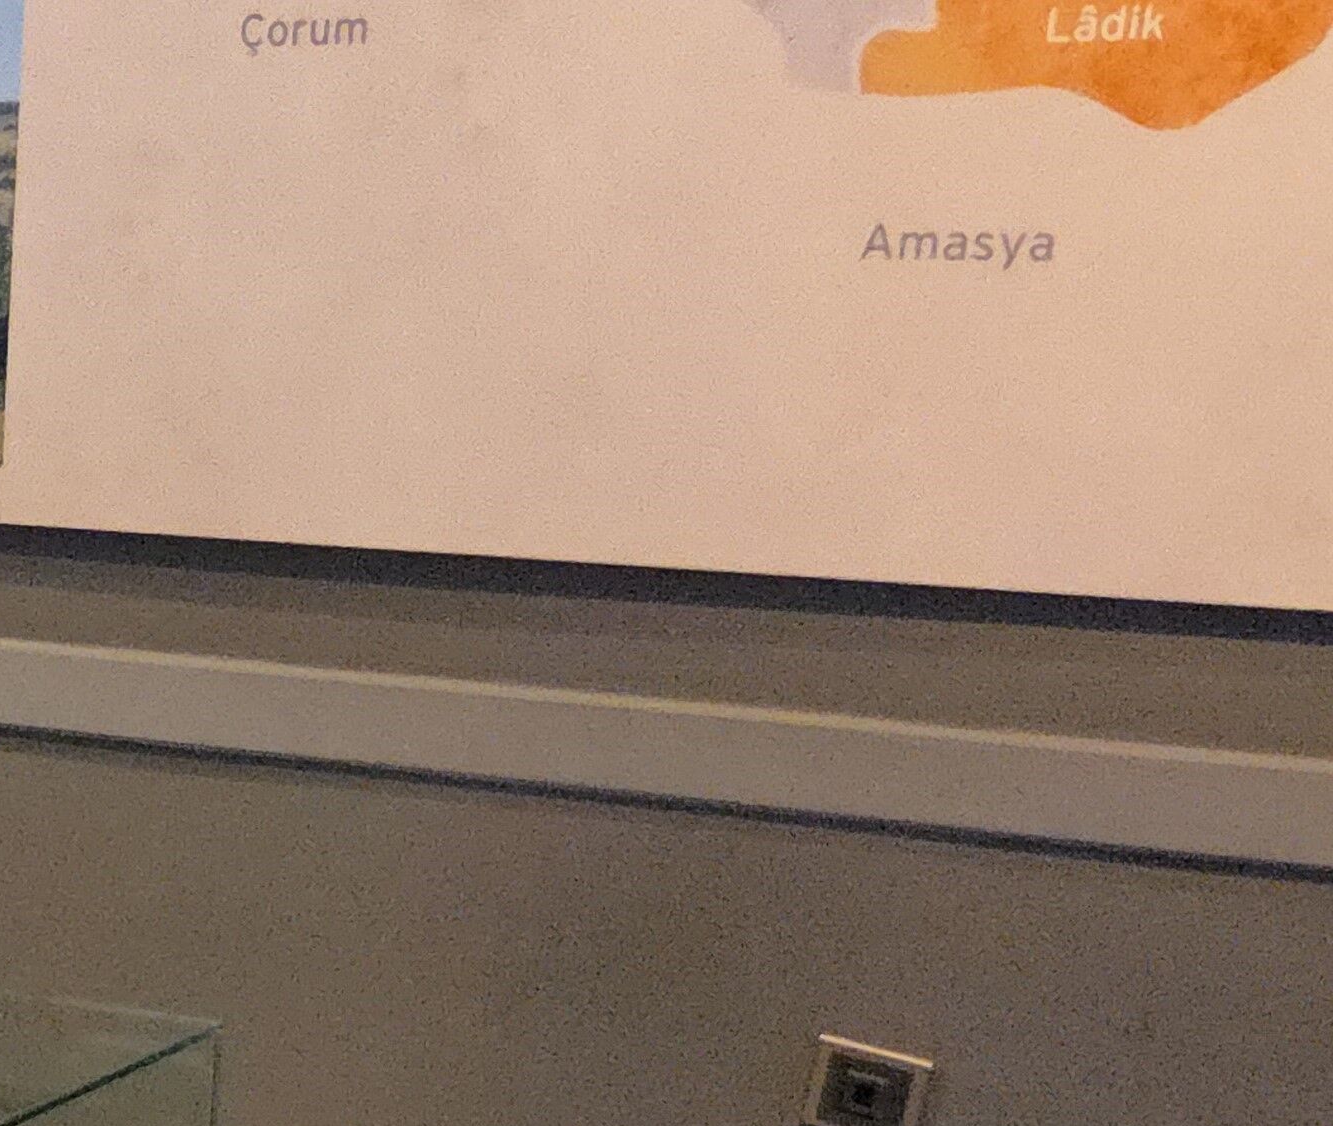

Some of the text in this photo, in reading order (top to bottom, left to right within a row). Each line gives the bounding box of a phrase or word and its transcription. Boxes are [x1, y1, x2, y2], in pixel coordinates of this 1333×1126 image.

[241, 13, 368, 57] Çorum
[1046, 3, 1165, 43] Lâdik
[858, 222, 1055, 271] Amasya
